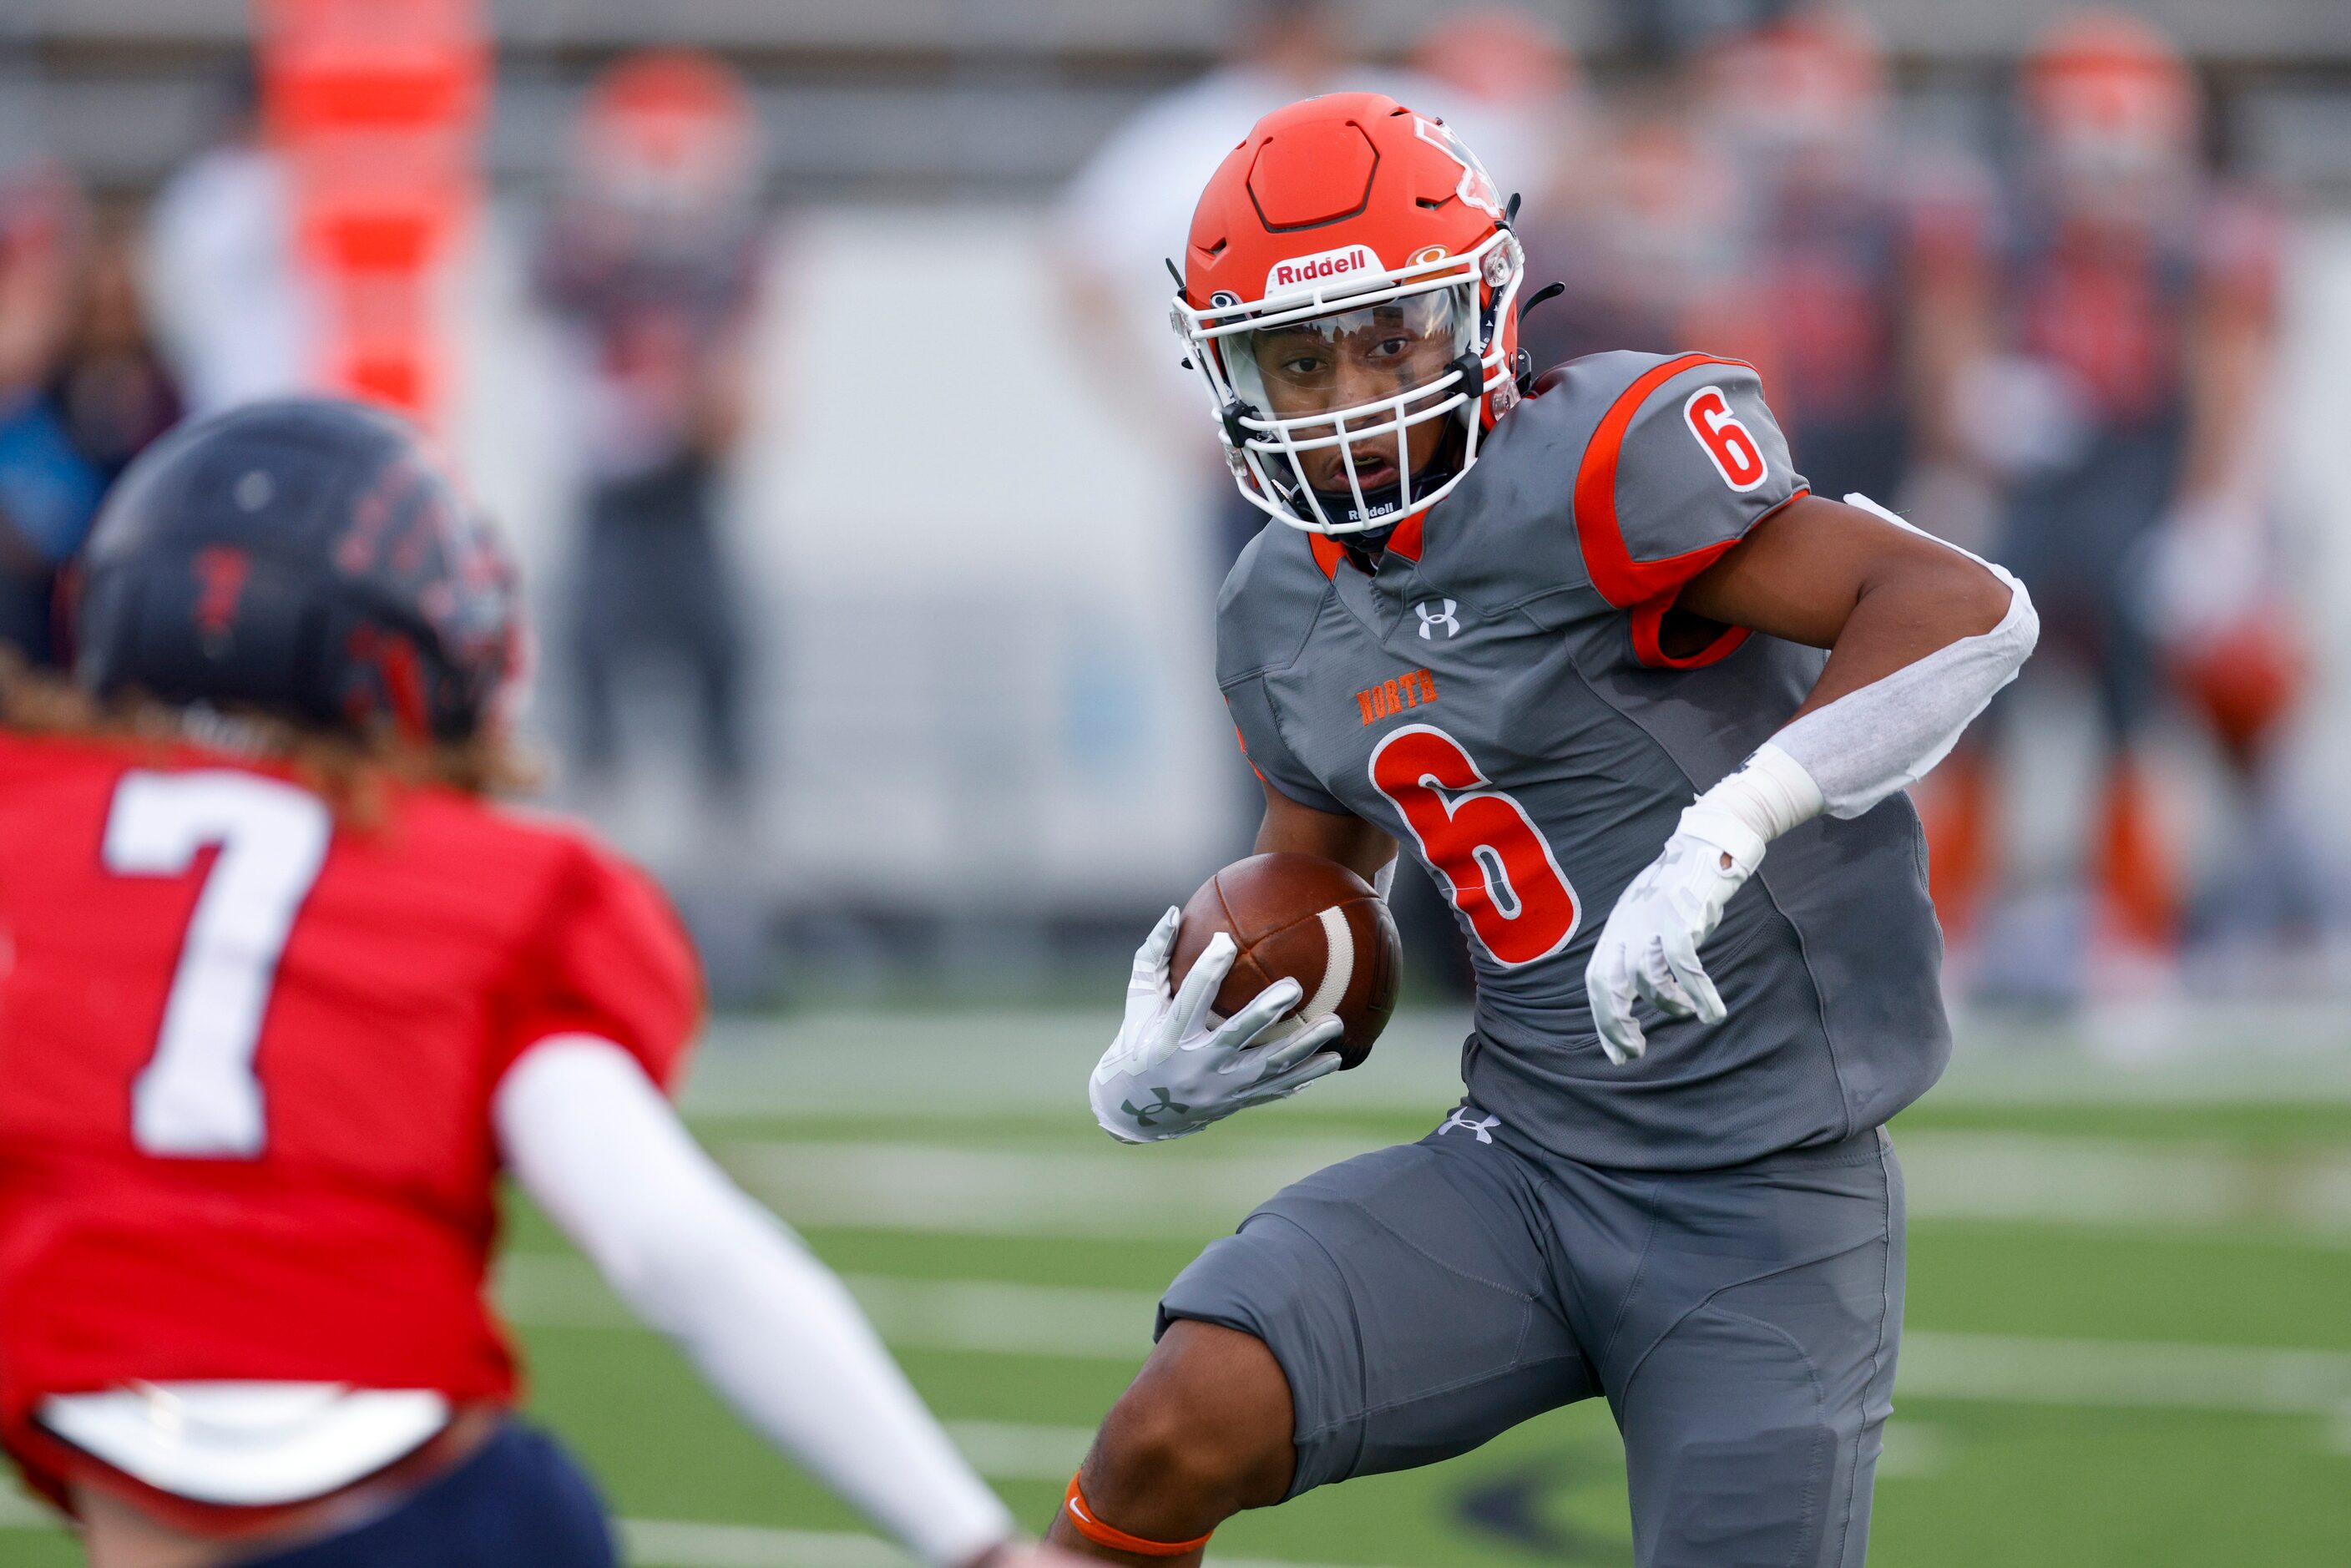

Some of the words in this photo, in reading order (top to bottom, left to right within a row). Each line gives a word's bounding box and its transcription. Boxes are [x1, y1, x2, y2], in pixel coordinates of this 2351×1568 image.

[1277, 250, 1366, 286] Riddell
[1683, 385, 1768, 493] 6
[1347, 502, 1394, 521] Rdell
[1356, 667, 1438, 727] NORTH
[1368, 723, 1582, 969] 6
[102, 768, 332, 1159] 7
